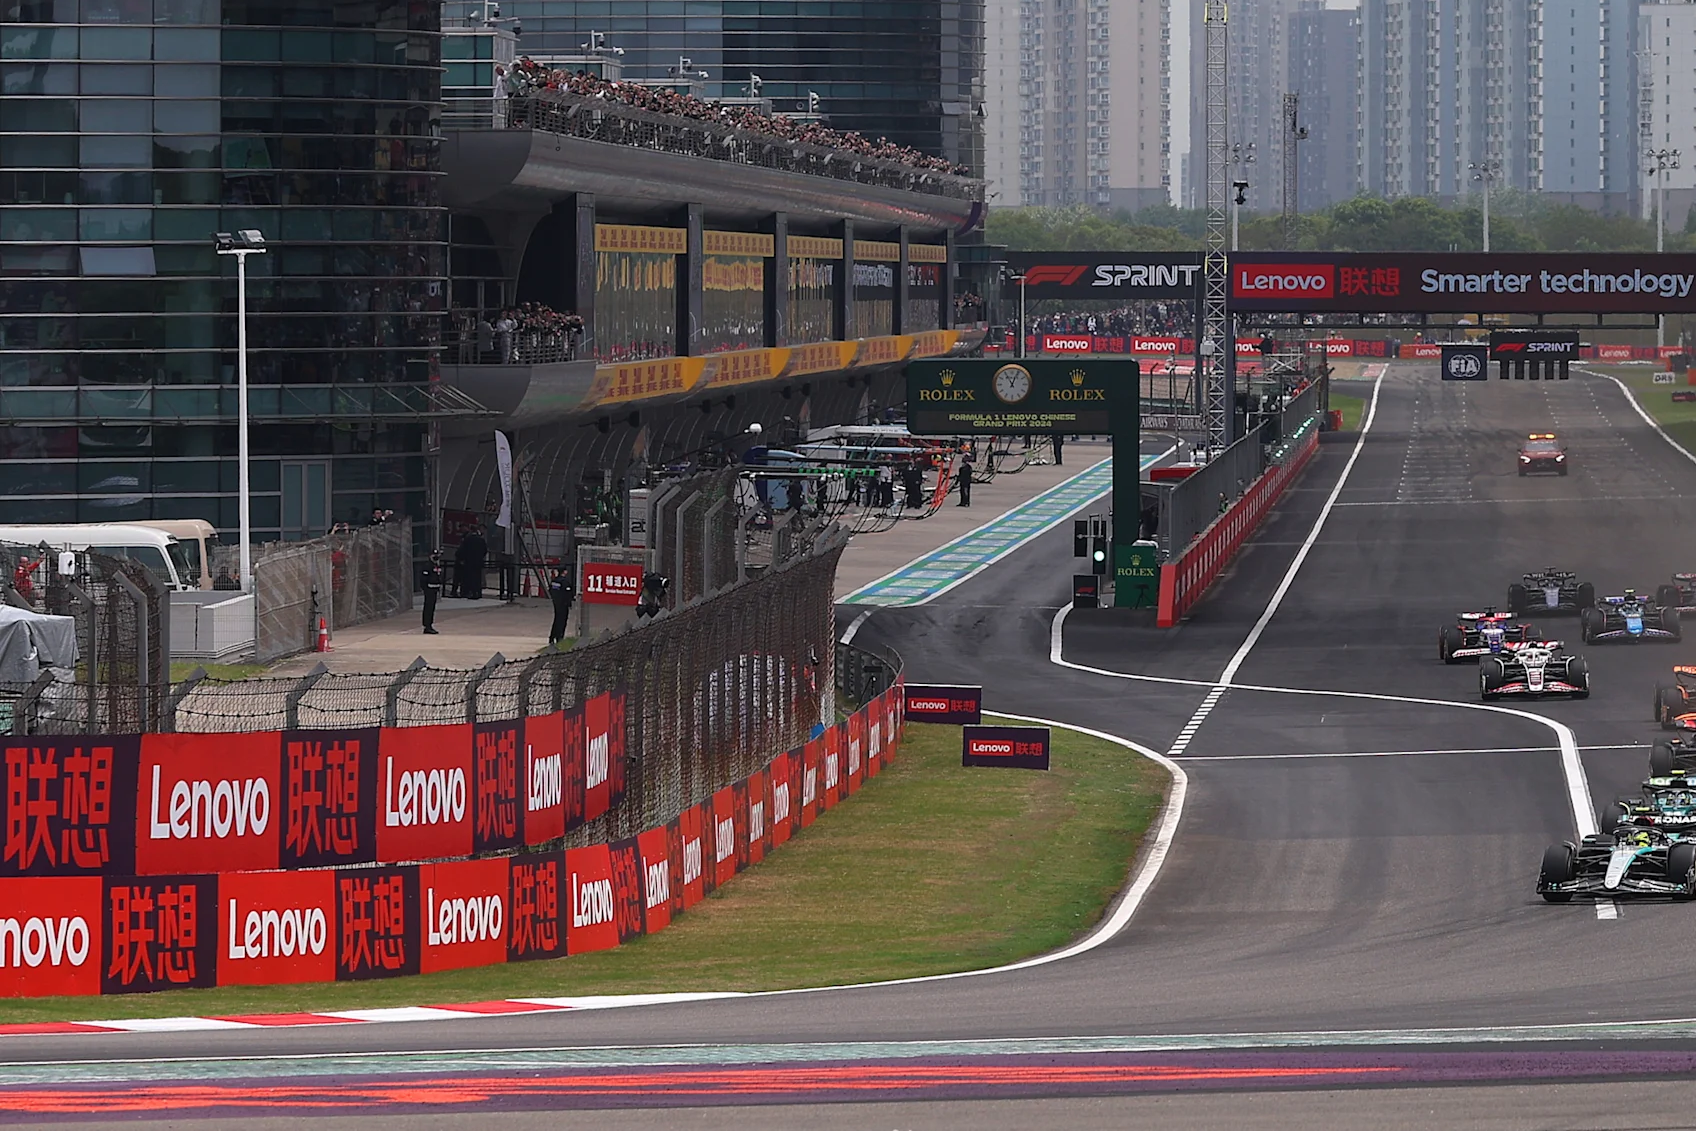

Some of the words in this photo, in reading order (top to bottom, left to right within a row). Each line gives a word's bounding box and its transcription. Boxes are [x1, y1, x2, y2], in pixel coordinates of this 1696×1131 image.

[1091, 265, 1202, 286] SPRINT
[1241, 272, 1326, 291] Lenovo
[1339, 267, 1400, 296] 联想
[1420, 269, 1532, 293] Smarter
[1539, 268, 1695, 298] technology
[1046, 338, 1089, 350] Lenovo
[1094, 337, 1124, 352] 联想
[1134, 339, 1176, 352] Lenovo
[1526, 342, 1575, 353] SPRINT
[919, 389, 976, 401] ROLEX
[1049, 389, 1106, 401] ROLEX
[1117, 568, 1155, 577] ROLEX
[587, 575, 603, 592] 11
[911, 700, 947, 710] Lenovo
[951, 699, 976, 713] 联想
[972, 743, 1011, 753] Lenovo
[1015, 742, 1043, 757] 联想
[4, 746, 114, 869] 联想
[149, 764, 270, 840] Lenovo
[286, 739, 360, 857] 联想
[385, 755, 466, 827] Lenovo
[476, 729, 516, 842] 联想
[527, 744, 562, 811] Lenovo
[0, 915, 91, 968] novo
[108, 884, 198, 987] 联想
[228, 898, 327, 960] Lenovo
[339, 874, 406, 973] 联想
[427, 887, 503, 947] Lenovo
[511, 860, 559, 955] 联想
[572, 871, 614, 930] Lenovo
